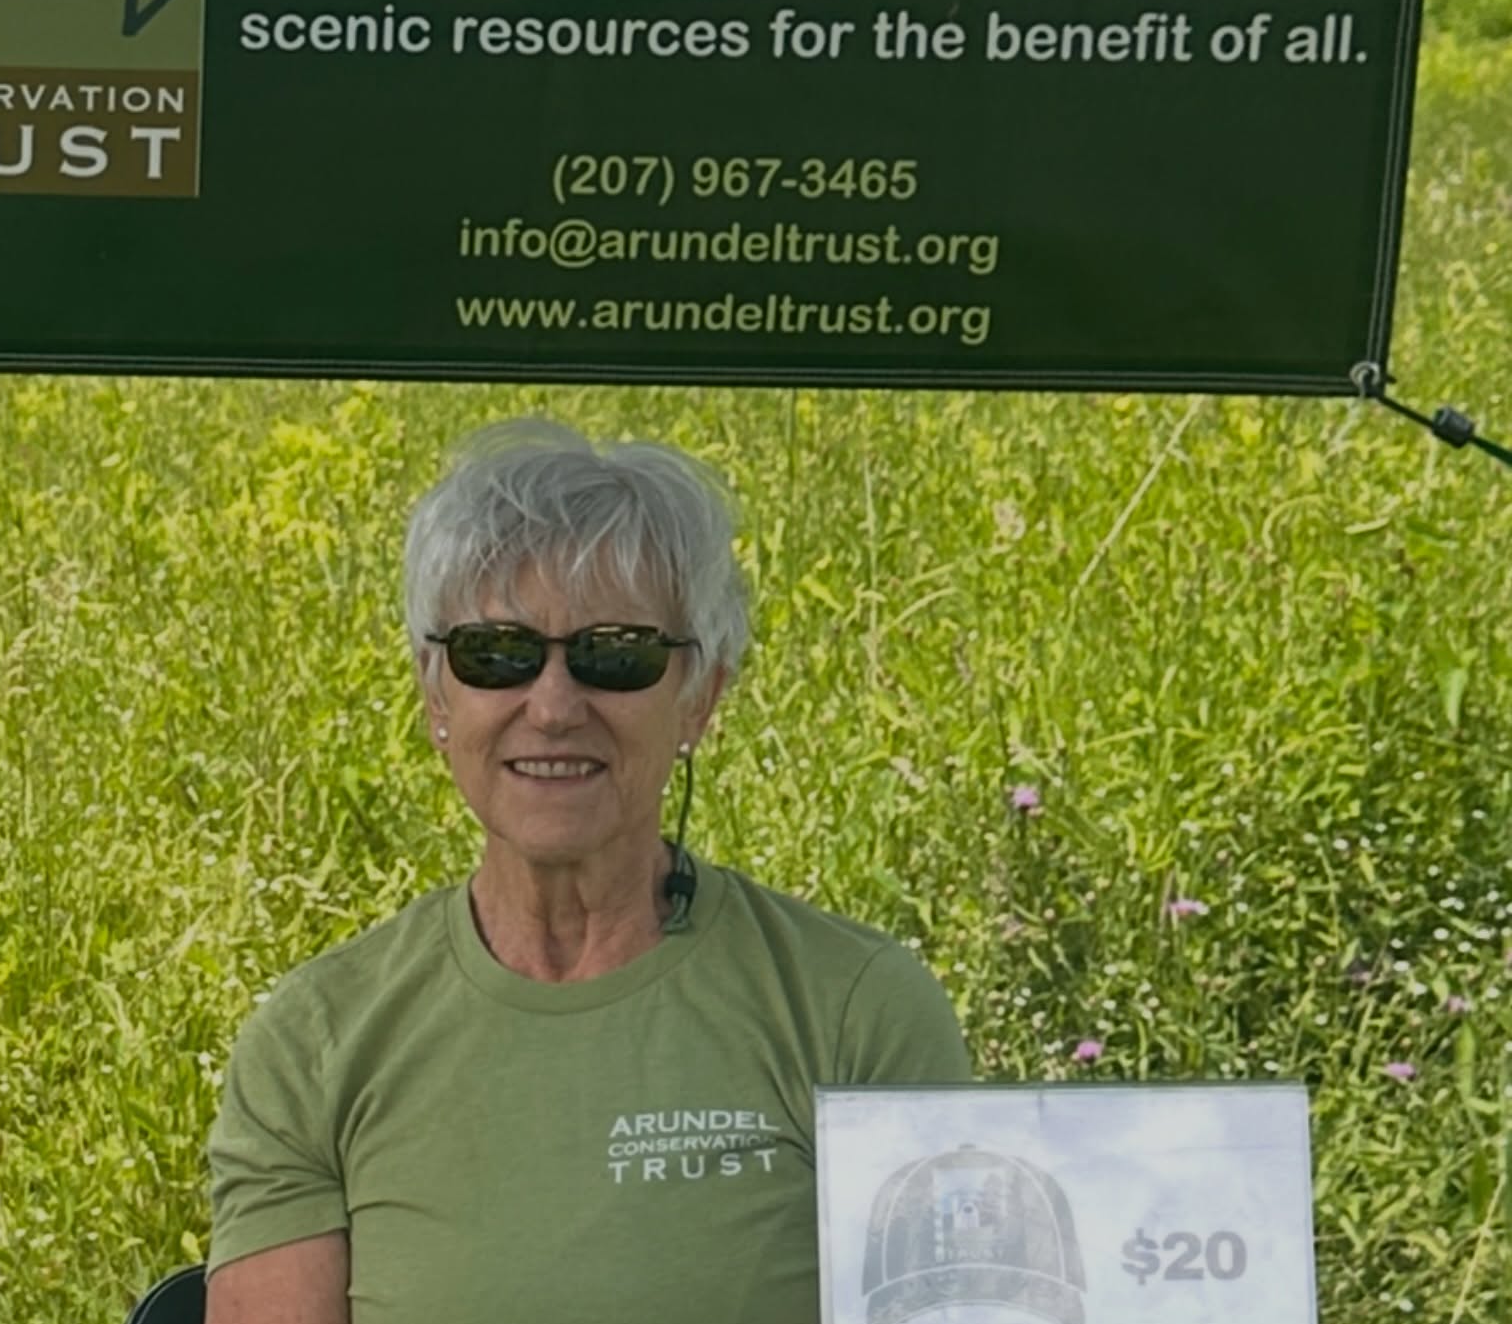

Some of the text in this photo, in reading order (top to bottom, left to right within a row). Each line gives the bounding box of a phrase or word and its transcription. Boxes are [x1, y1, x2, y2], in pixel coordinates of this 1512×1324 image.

[240, 6, 1369, 63] scenic resources for the benefit of all.
[553, 154, 917, 207] (207) 967-3465
[460, 219, 998, 275] info@arundeltrust.org
[457, 295, 991, 344] www.arundeltrust.org
[610, 1110, 780, 1137] ARUNDEL
[608, 1149, 778, 1184] TRUST
[1121, 1229, 1246, 1284] $20
